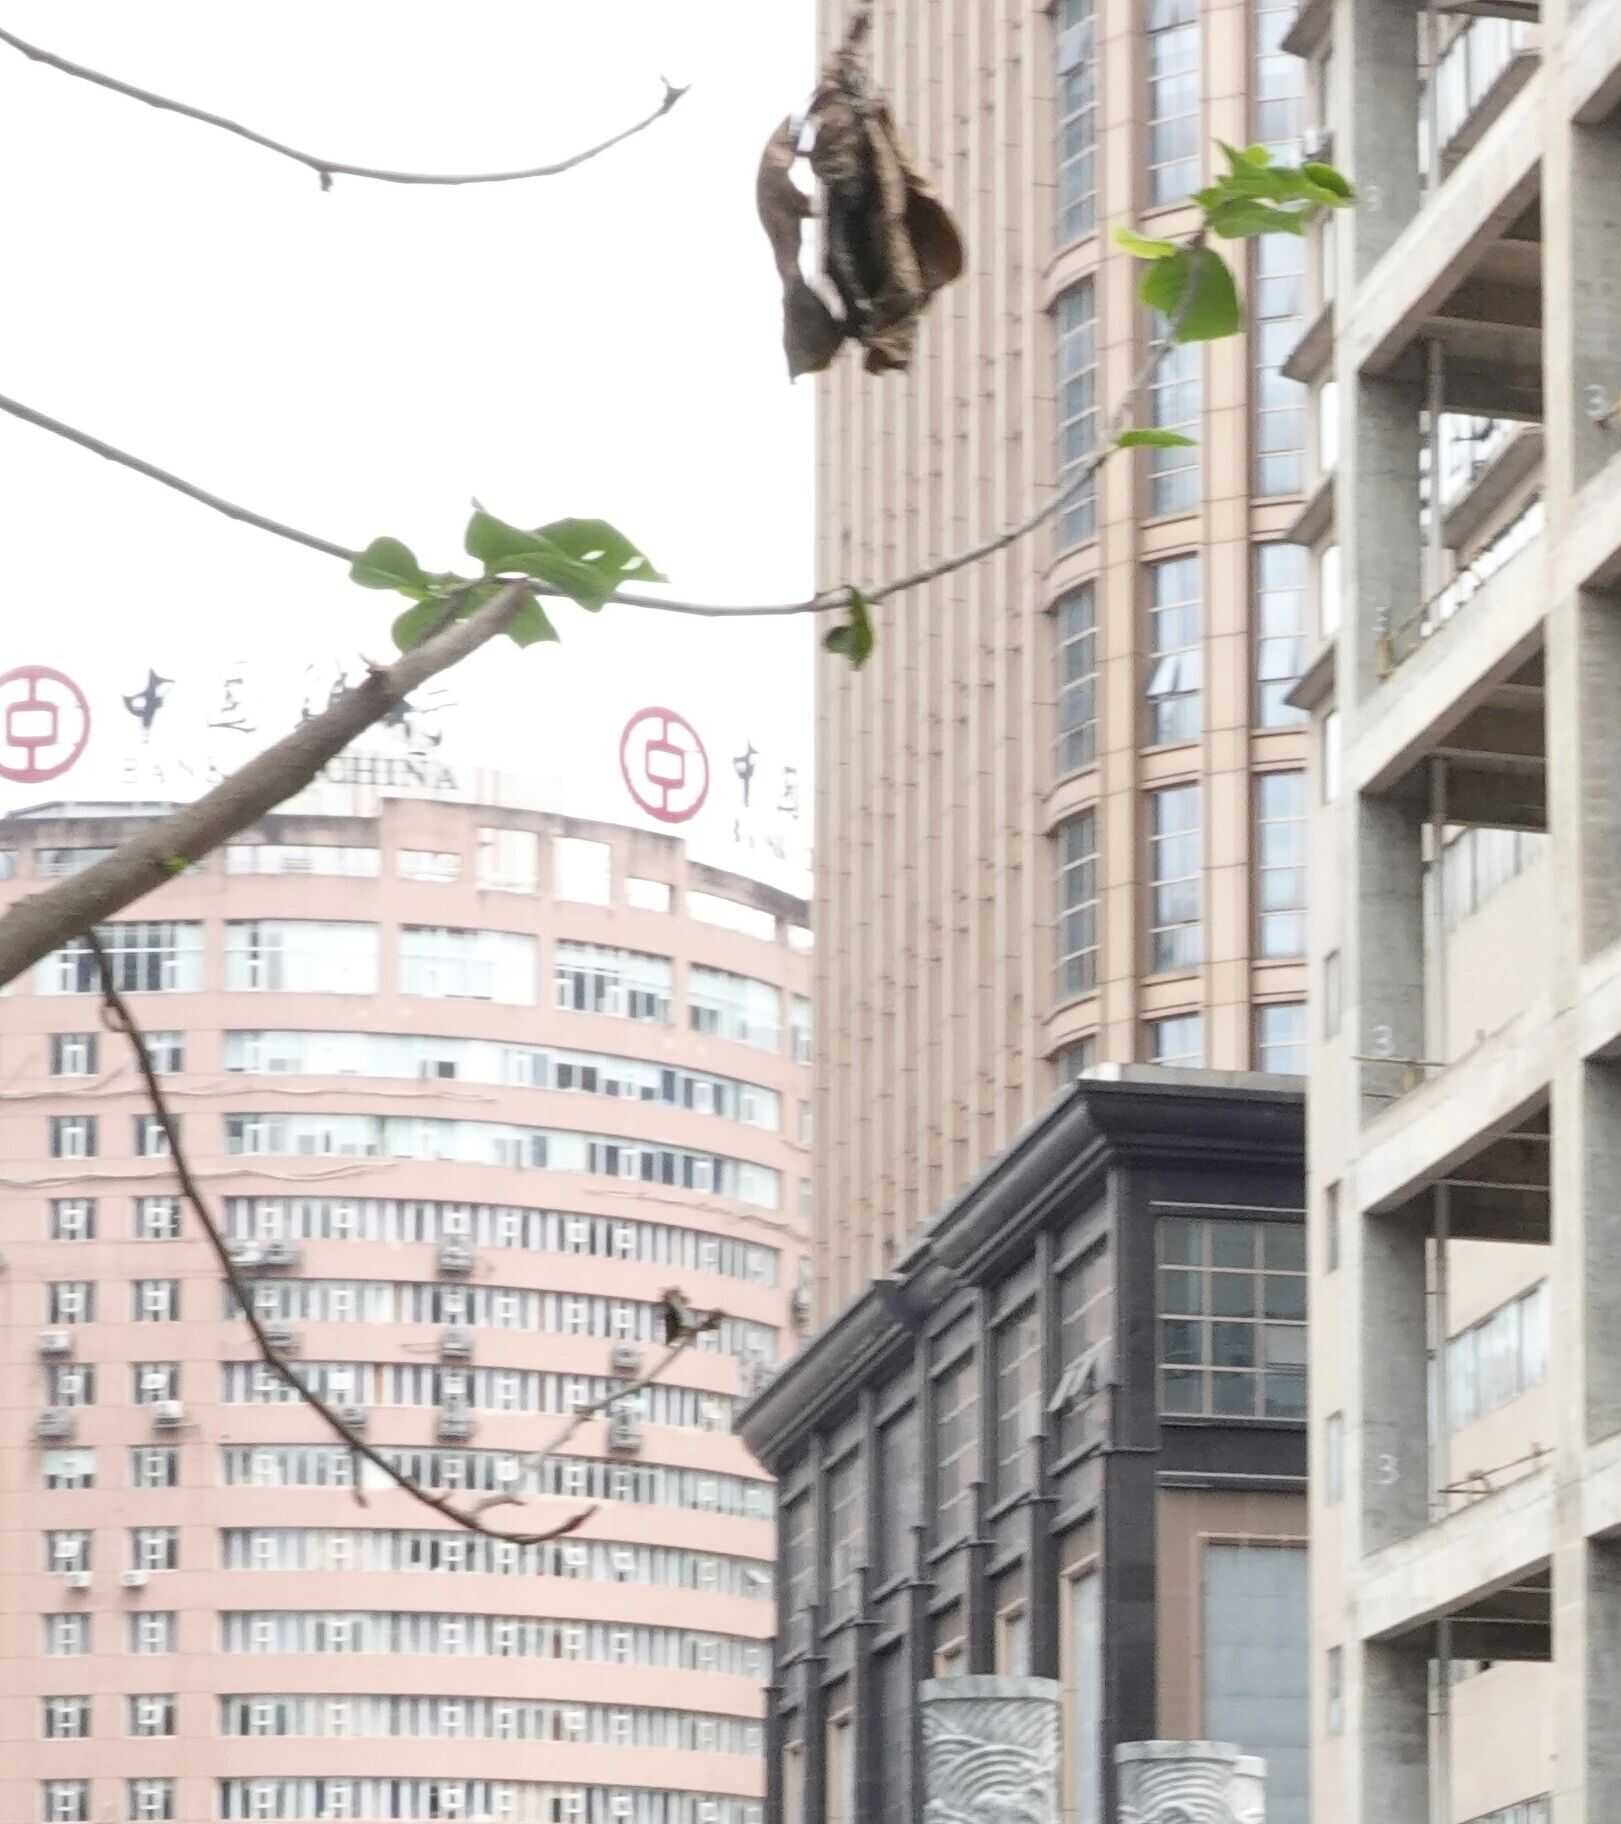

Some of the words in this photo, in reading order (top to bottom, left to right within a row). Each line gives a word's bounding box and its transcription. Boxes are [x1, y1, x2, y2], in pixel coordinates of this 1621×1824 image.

[1584, 384, 1609, 417] 3
[1371, 1025, 1394, 1056] 3
[1374, 1454, 1400, 1486] 3
